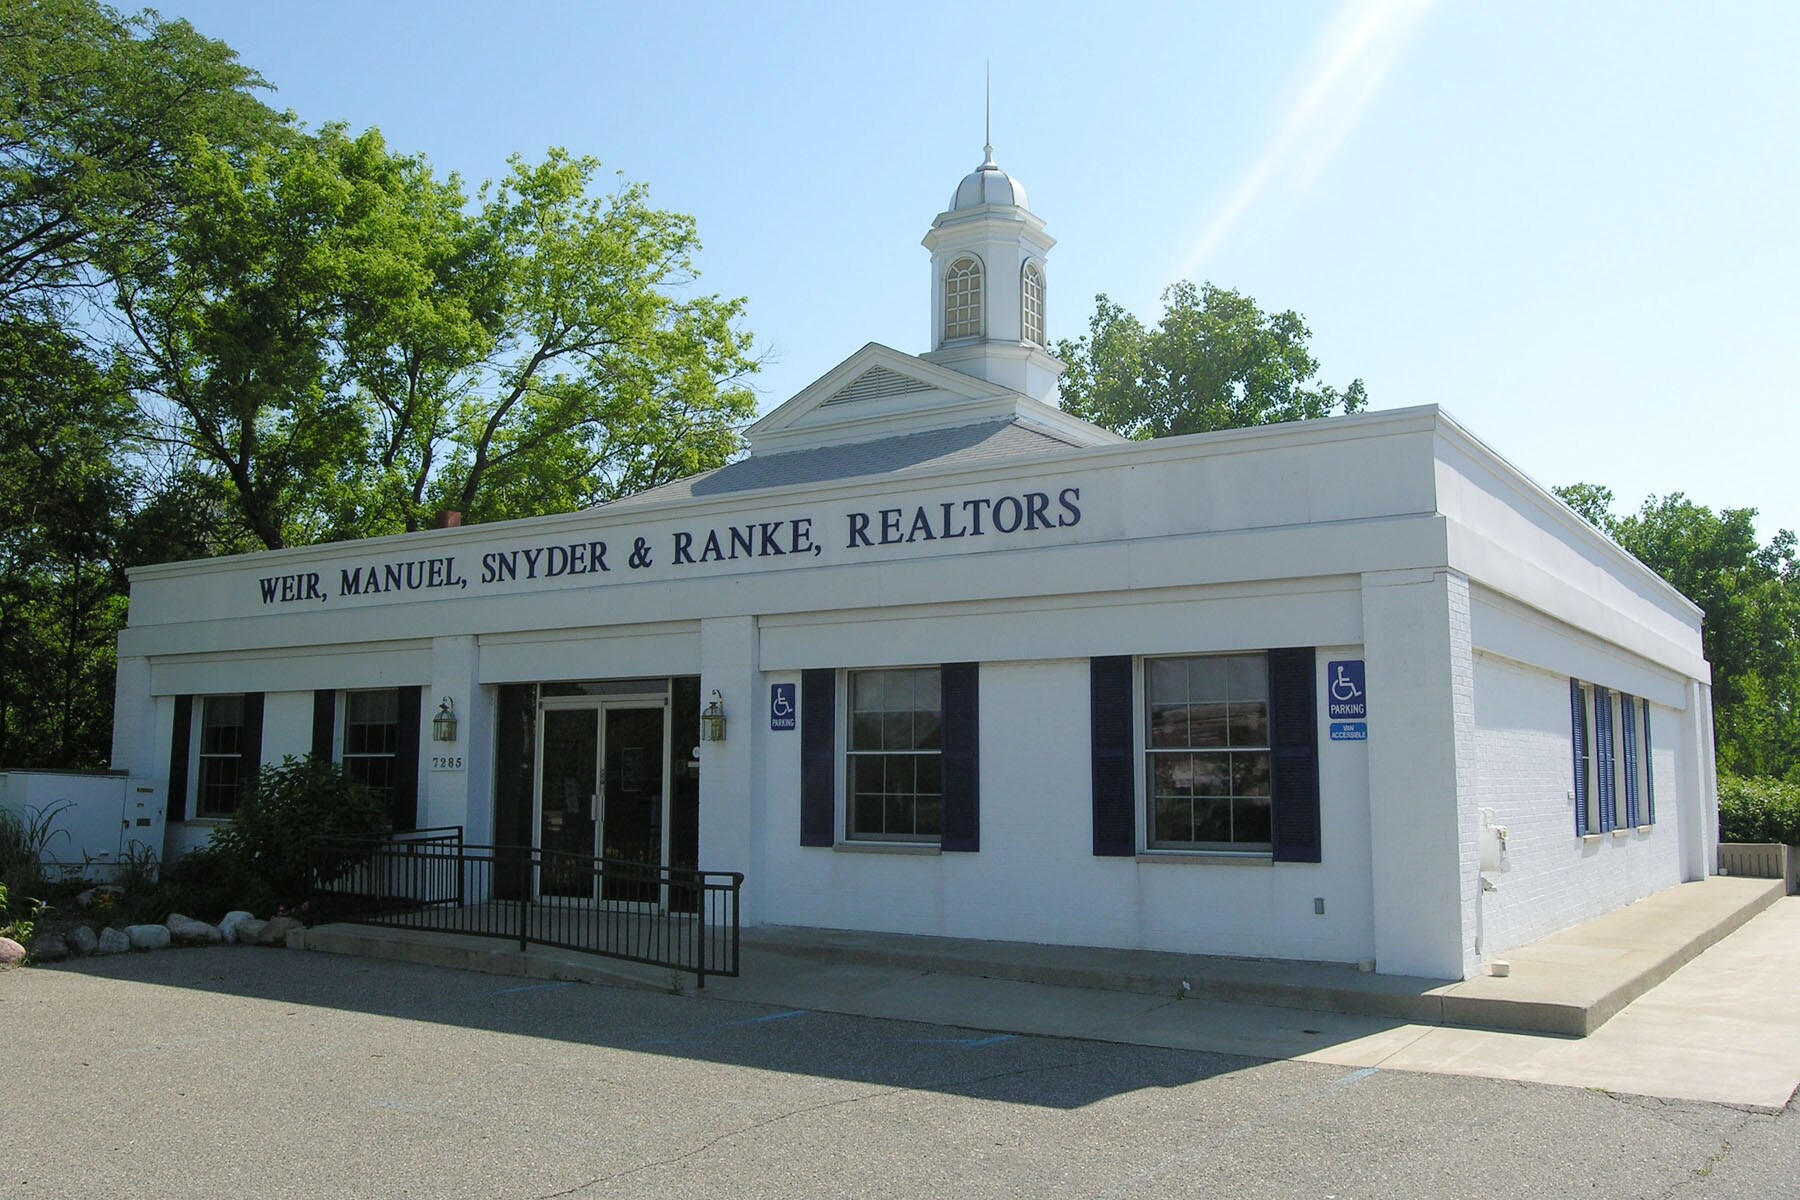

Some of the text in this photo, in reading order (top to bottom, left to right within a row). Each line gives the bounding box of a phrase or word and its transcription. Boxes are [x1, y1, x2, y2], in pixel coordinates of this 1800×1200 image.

[259, 488, 1081, 604] WEIR, MANUEL, SNYDER & RANKE, REALTORS
[1331, 704, 1365, 714] PARKING
[772, 719, 794, 727] PARKING
[432, 757, 462, 768] 7285
